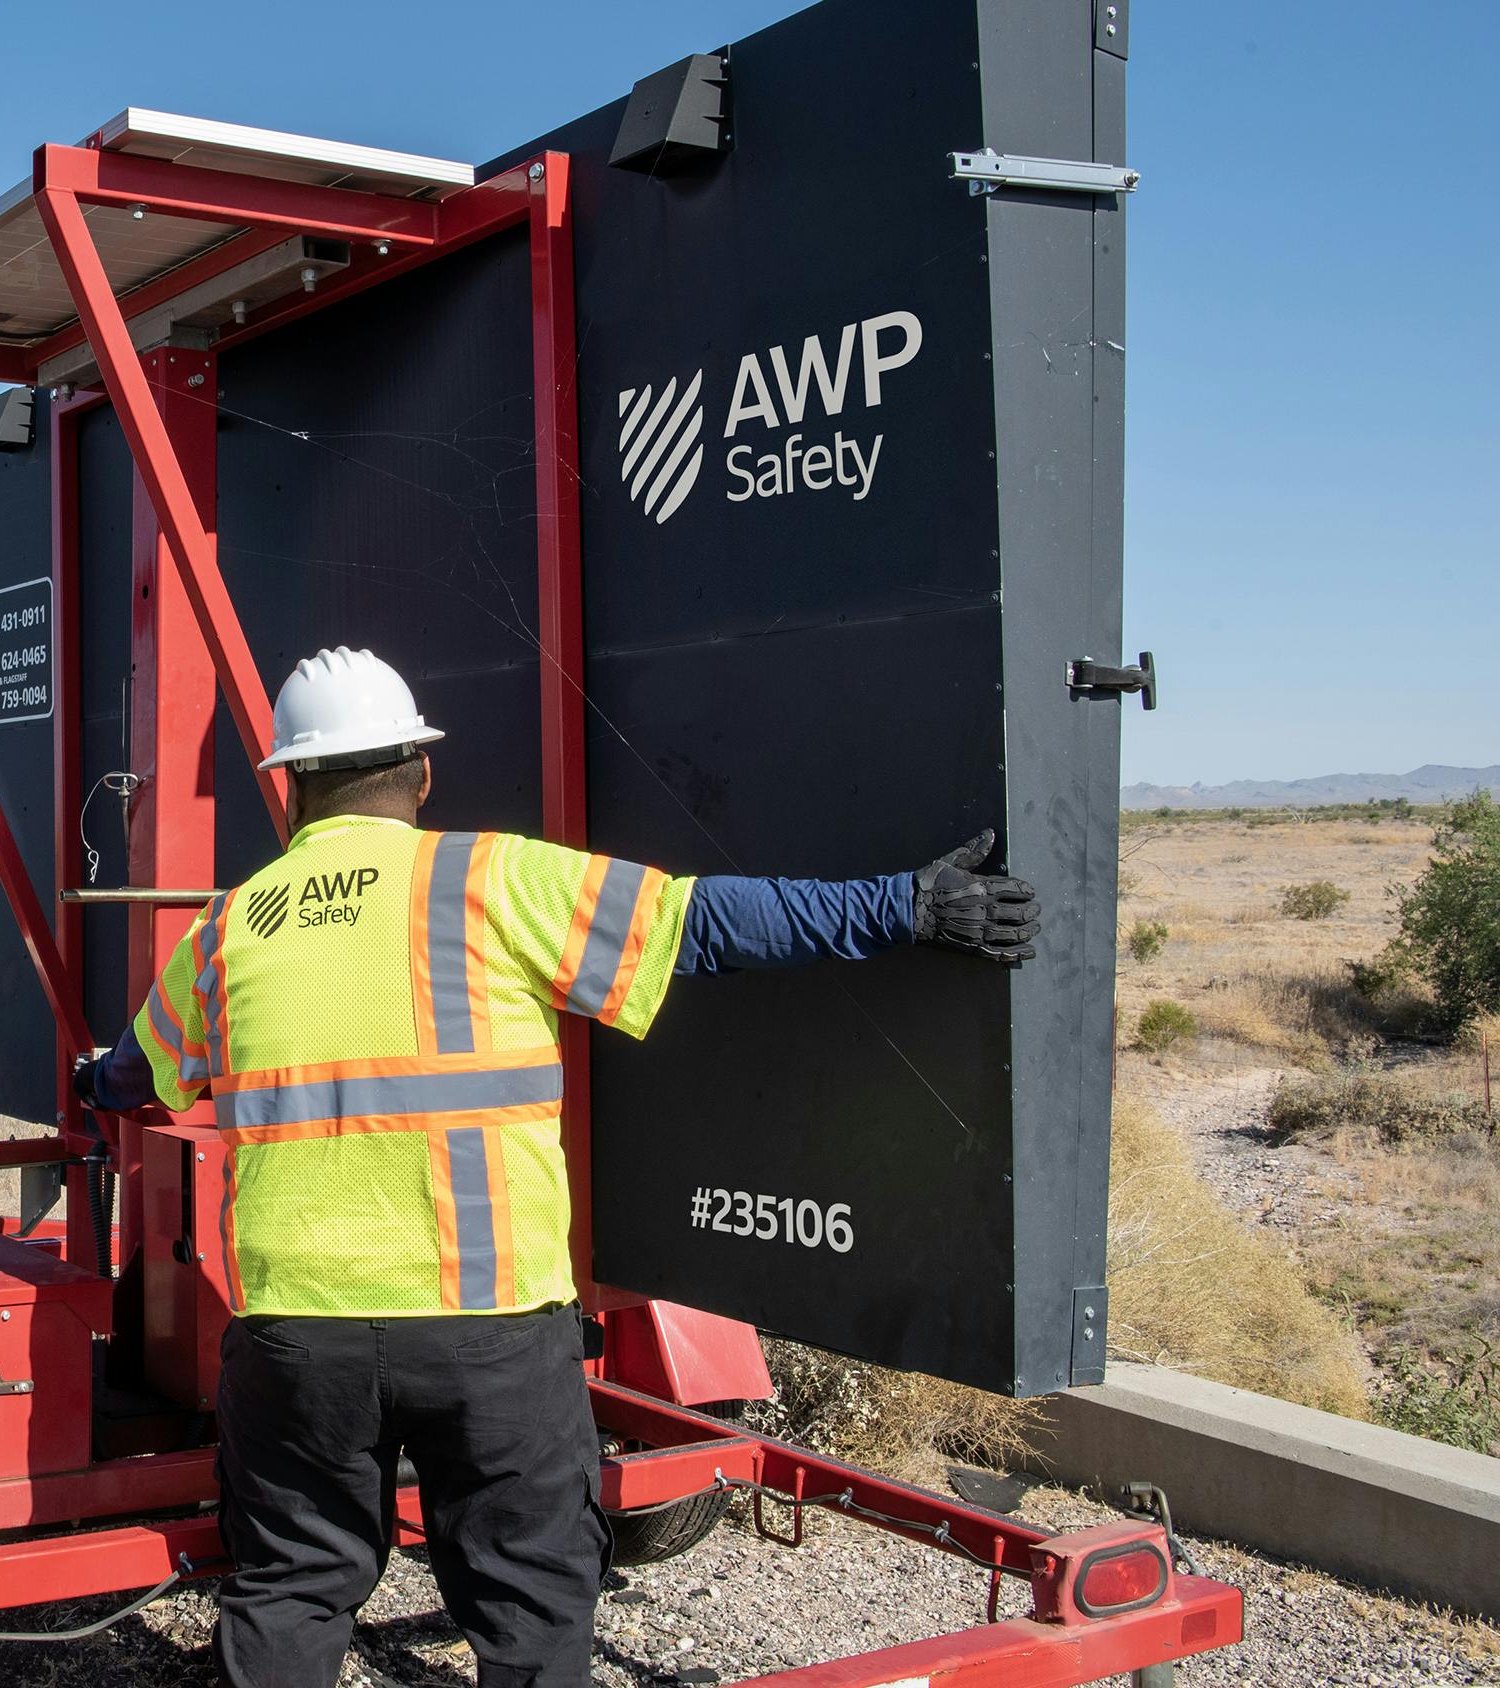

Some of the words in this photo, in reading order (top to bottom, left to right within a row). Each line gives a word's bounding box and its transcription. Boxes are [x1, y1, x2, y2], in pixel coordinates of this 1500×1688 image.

[723, 310, 923, 438] AWP
[725, 431, 884, 502] Safety
[1, 604, 45, 632] 431-0911
[1, 645, 46, 671] 624-0465
[3, 672, 28, 685] FLAGSTAFF
[1, 685, 47, 710] 759-0094
[298, 868, 379, 906] AWP
[298, 904, 362, 928] Safety
[690, 1187, 854, 1253] #235106
